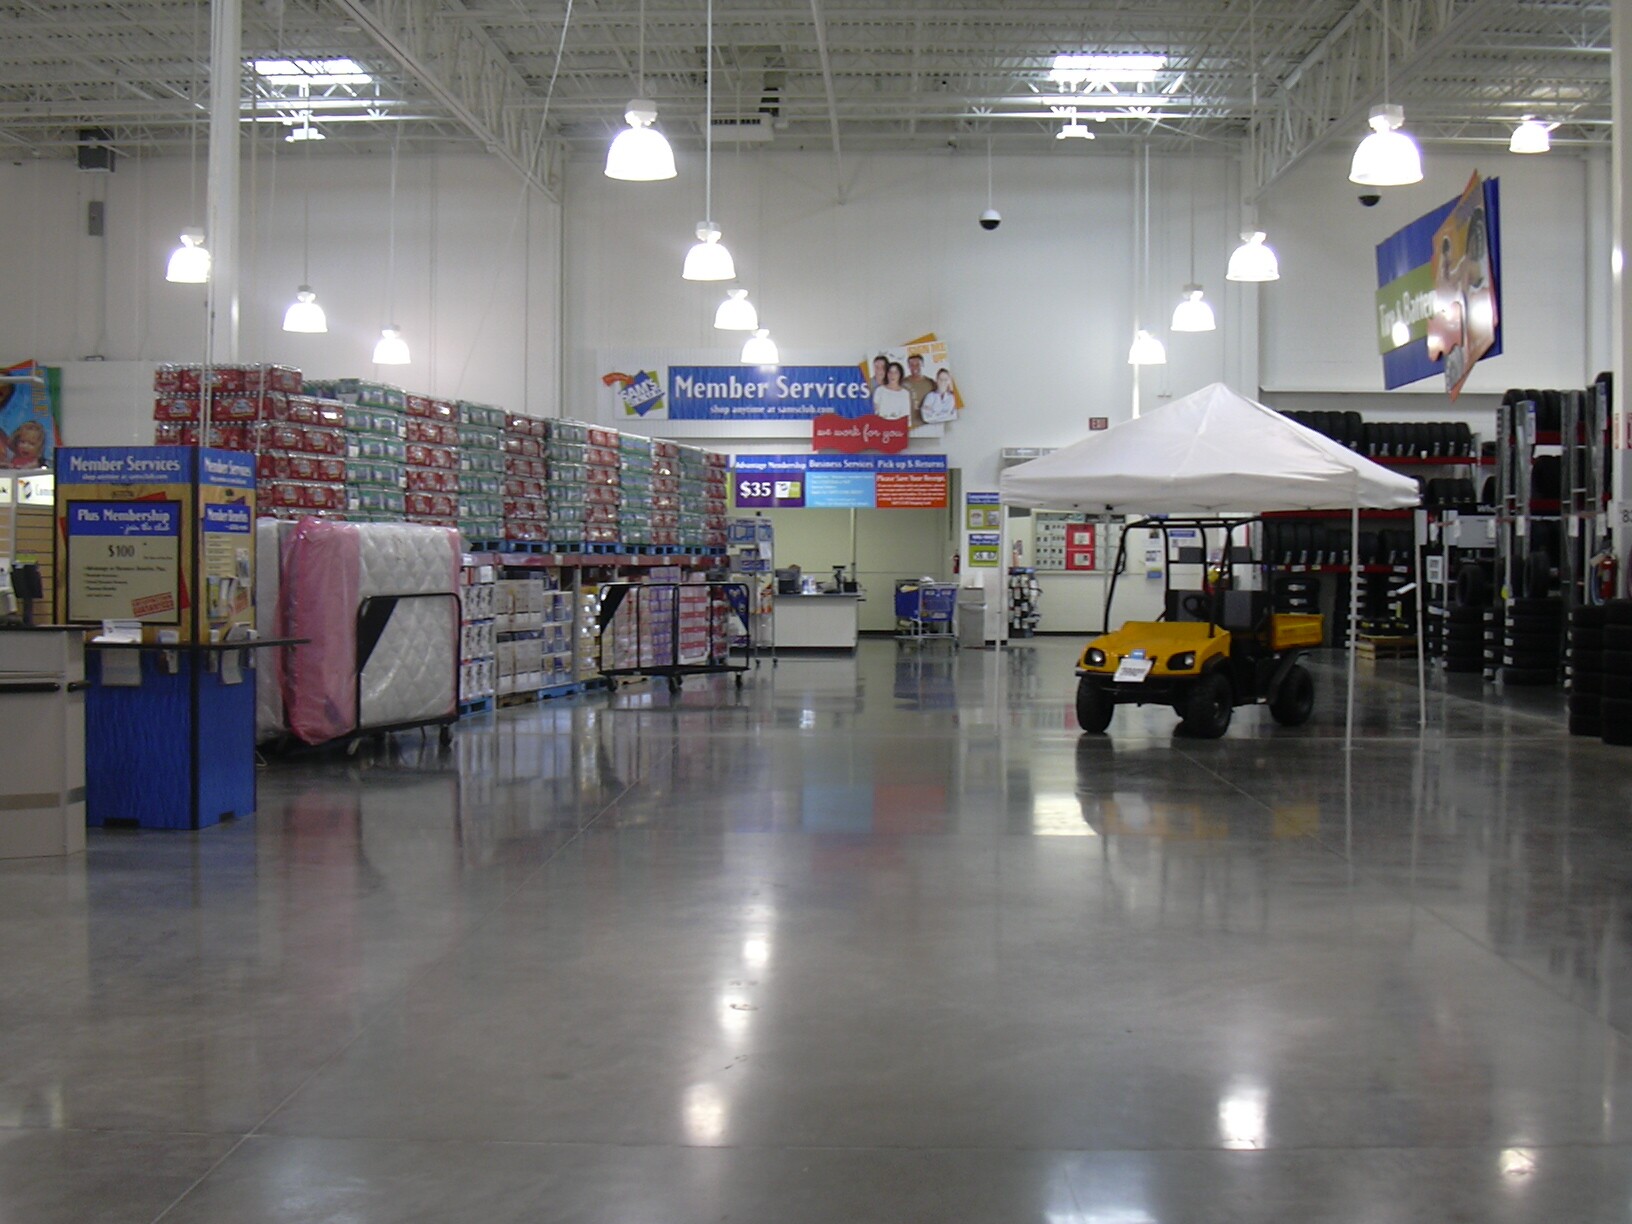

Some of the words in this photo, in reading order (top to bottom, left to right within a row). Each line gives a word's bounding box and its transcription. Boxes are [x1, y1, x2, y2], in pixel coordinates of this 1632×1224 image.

[675, 375, 769, 399] Member
[775, 375, 871, 399] Services
[709, 404, 730, 415] shop
[732, 404, 765, 415] anytime
[767, 405, 776, 414] at
[777, 404, 835, 414] samsclub.com
[834, 425, 861, 437] work
[862, 423, 881, 442] for
[883, 429, 904, 444] you
[70, 455, 123, 471] Member
[126, 455, 180, 471] Services
[809, 459, 841, 468] Business
[844, 459, 874, 468] Services
[878, 460, 893, 468] Pick
[739, 480, 771, 499] $35
[77, 508, 100, 521] Plus
[103, 508, 170, 523] Membership
[108, 544, 135, 558] $100
